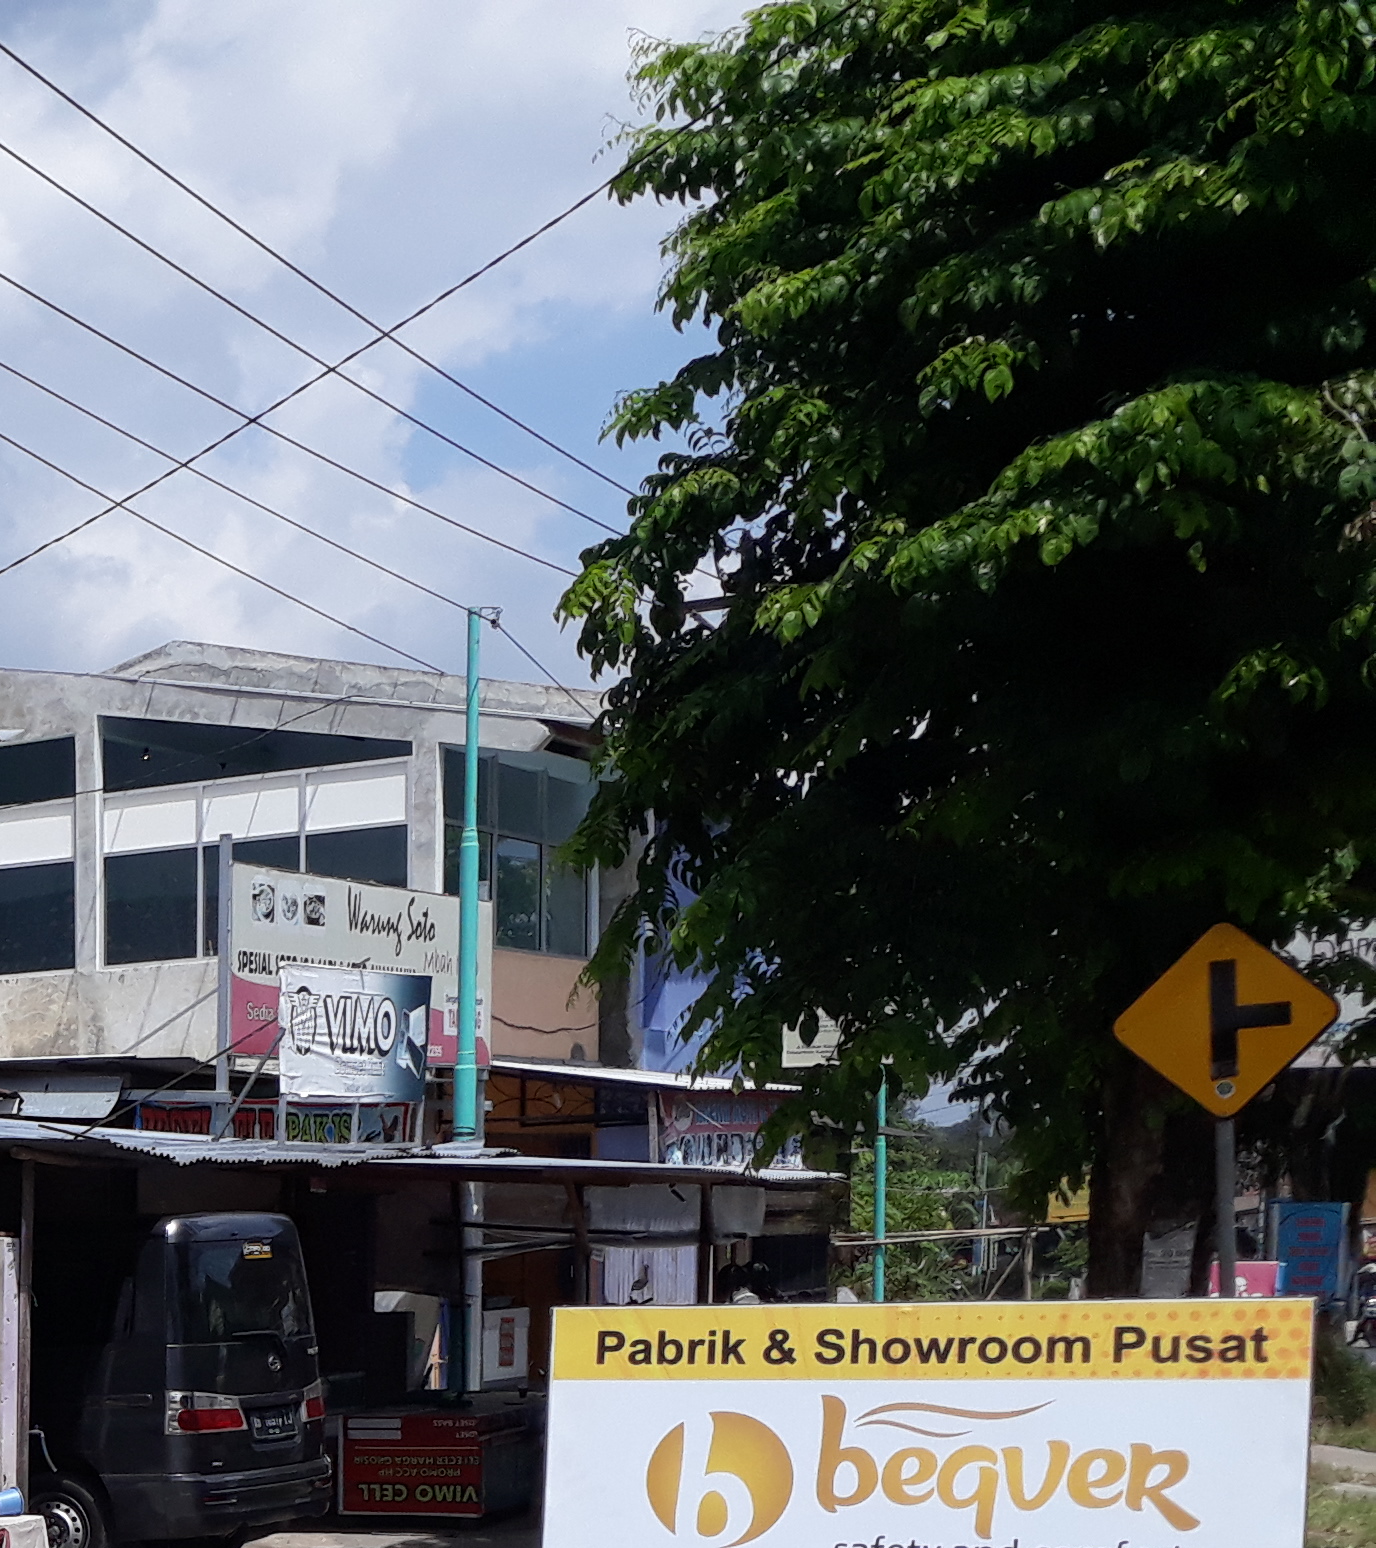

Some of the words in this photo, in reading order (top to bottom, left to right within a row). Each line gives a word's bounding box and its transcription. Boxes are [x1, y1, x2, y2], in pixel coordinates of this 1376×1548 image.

[348, 885, 402, 957] Warung
[407, 896, 435, 943] Soto
[238, 950, 272, 976] SPESIAL
[324, 996, 397, 1056] VIMO
[595, 1329, 746, 1365] Pabrik
[762, 1329, 798, 1365] &
[814, 1328, 1092, 1365] Showroom
[1113, 1326, 1269, 1364] Pusat
[357, 1483, 407, 1502] CELL
[414, 1483, 479, 1503] VIMO
